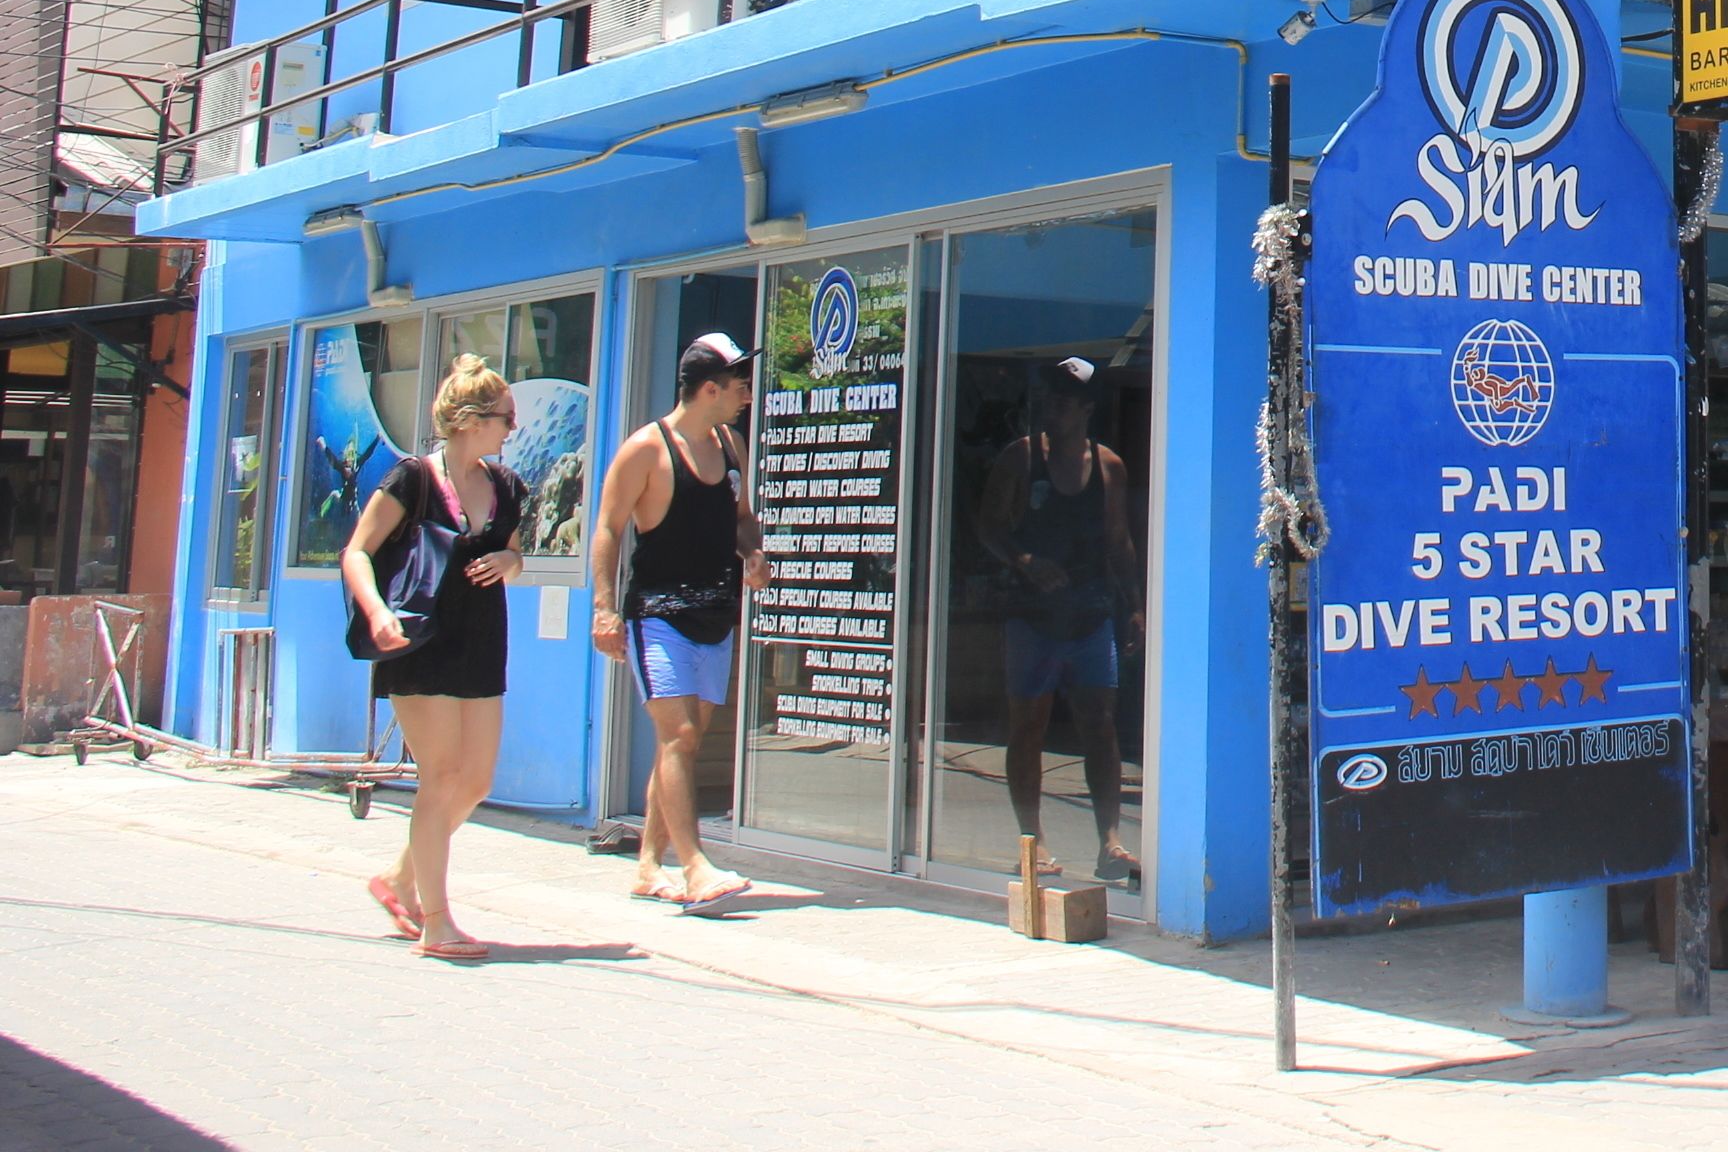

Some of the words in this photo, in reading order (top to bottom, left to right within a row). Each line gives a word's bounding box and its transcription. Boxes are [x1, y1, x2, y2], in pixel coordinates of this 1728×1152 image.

[1689, 77, 1728, 92] KITCHEN
[1384, 107, 1606, 248] Siam
[1354, 255, 1457, 297] SCUBA
[1468, 260, 1532, 302] DIVE
[1542, 264, 1642, 306] CENTER
[765, 390, 803, 417] SCUBA
[809, 387, 841, 414] DIVE
[845, 383, 897, 412] CENTER
[766, 428, 785, 446] PADI
[794, 425, 816, 445] STAR
[817, 424, 838, 444] DIVE
[838, 422, 874, 443] RESORT
[766, 454, 784, 472] TRY
[783, 452, 807, 472] DIVES
[813, 450, 861, 471] DISCOVERY
[861, 449, 891, 470] DIVING
[764, 480, 784, 499] PADI
[785, 479, 808, 498] OPEN
[809, 478, 840, 497] WATER
[840, 477, 882, 497] COURSES
[1441, 465, 1567, 513] PADI
[763, 506, 780, 525] PADI
[780, 506, 815, 525] ADVANCED
[815, 506, 835, 525] OPEN
[835, 505, 861, 525] WATER
[861, 505, 897, 525] COURSES
[801, 534, 823, 553] FIRST
[822, 534, 861, 553] RESPONSE
[861, 534, 896, 553] COURSES
[1411, 532, 1444, 580] 5
[1458, 528, 1606, 579] STAR
[780, 561, 813, 580] RESCUE
[813, 561, 854, 580] COURSES
[759, 588, 779, 605] PADI
[819, 590, 853, 609] COURSES
[853, 592, 894, 611] AVAILABLE
[759, 614, 778, 632] PADI
[779, 615, 797, 633] PRO
[798, 616, 837, 636] COURSES
[838, 617, 886, 639] AVAILABLE
[1323, 598, 1453, 652] DIVE
[1470, 587, 1678, 644] RESORT
[805, 649, 829, 668] SMALL
[830, 651, 855, 670] DIVING
[855, 653, 887, 672] GROUPS
[811, 674, 861, 695] SNORKELLING
[861, 677, 885, 696] TRIPS
[776, 695, 797, 712] SCUBA
[851, 700, 865, 720] FOR
[865, 702, 883, 721] SALE
[864, 726, 883, 745] SALE
